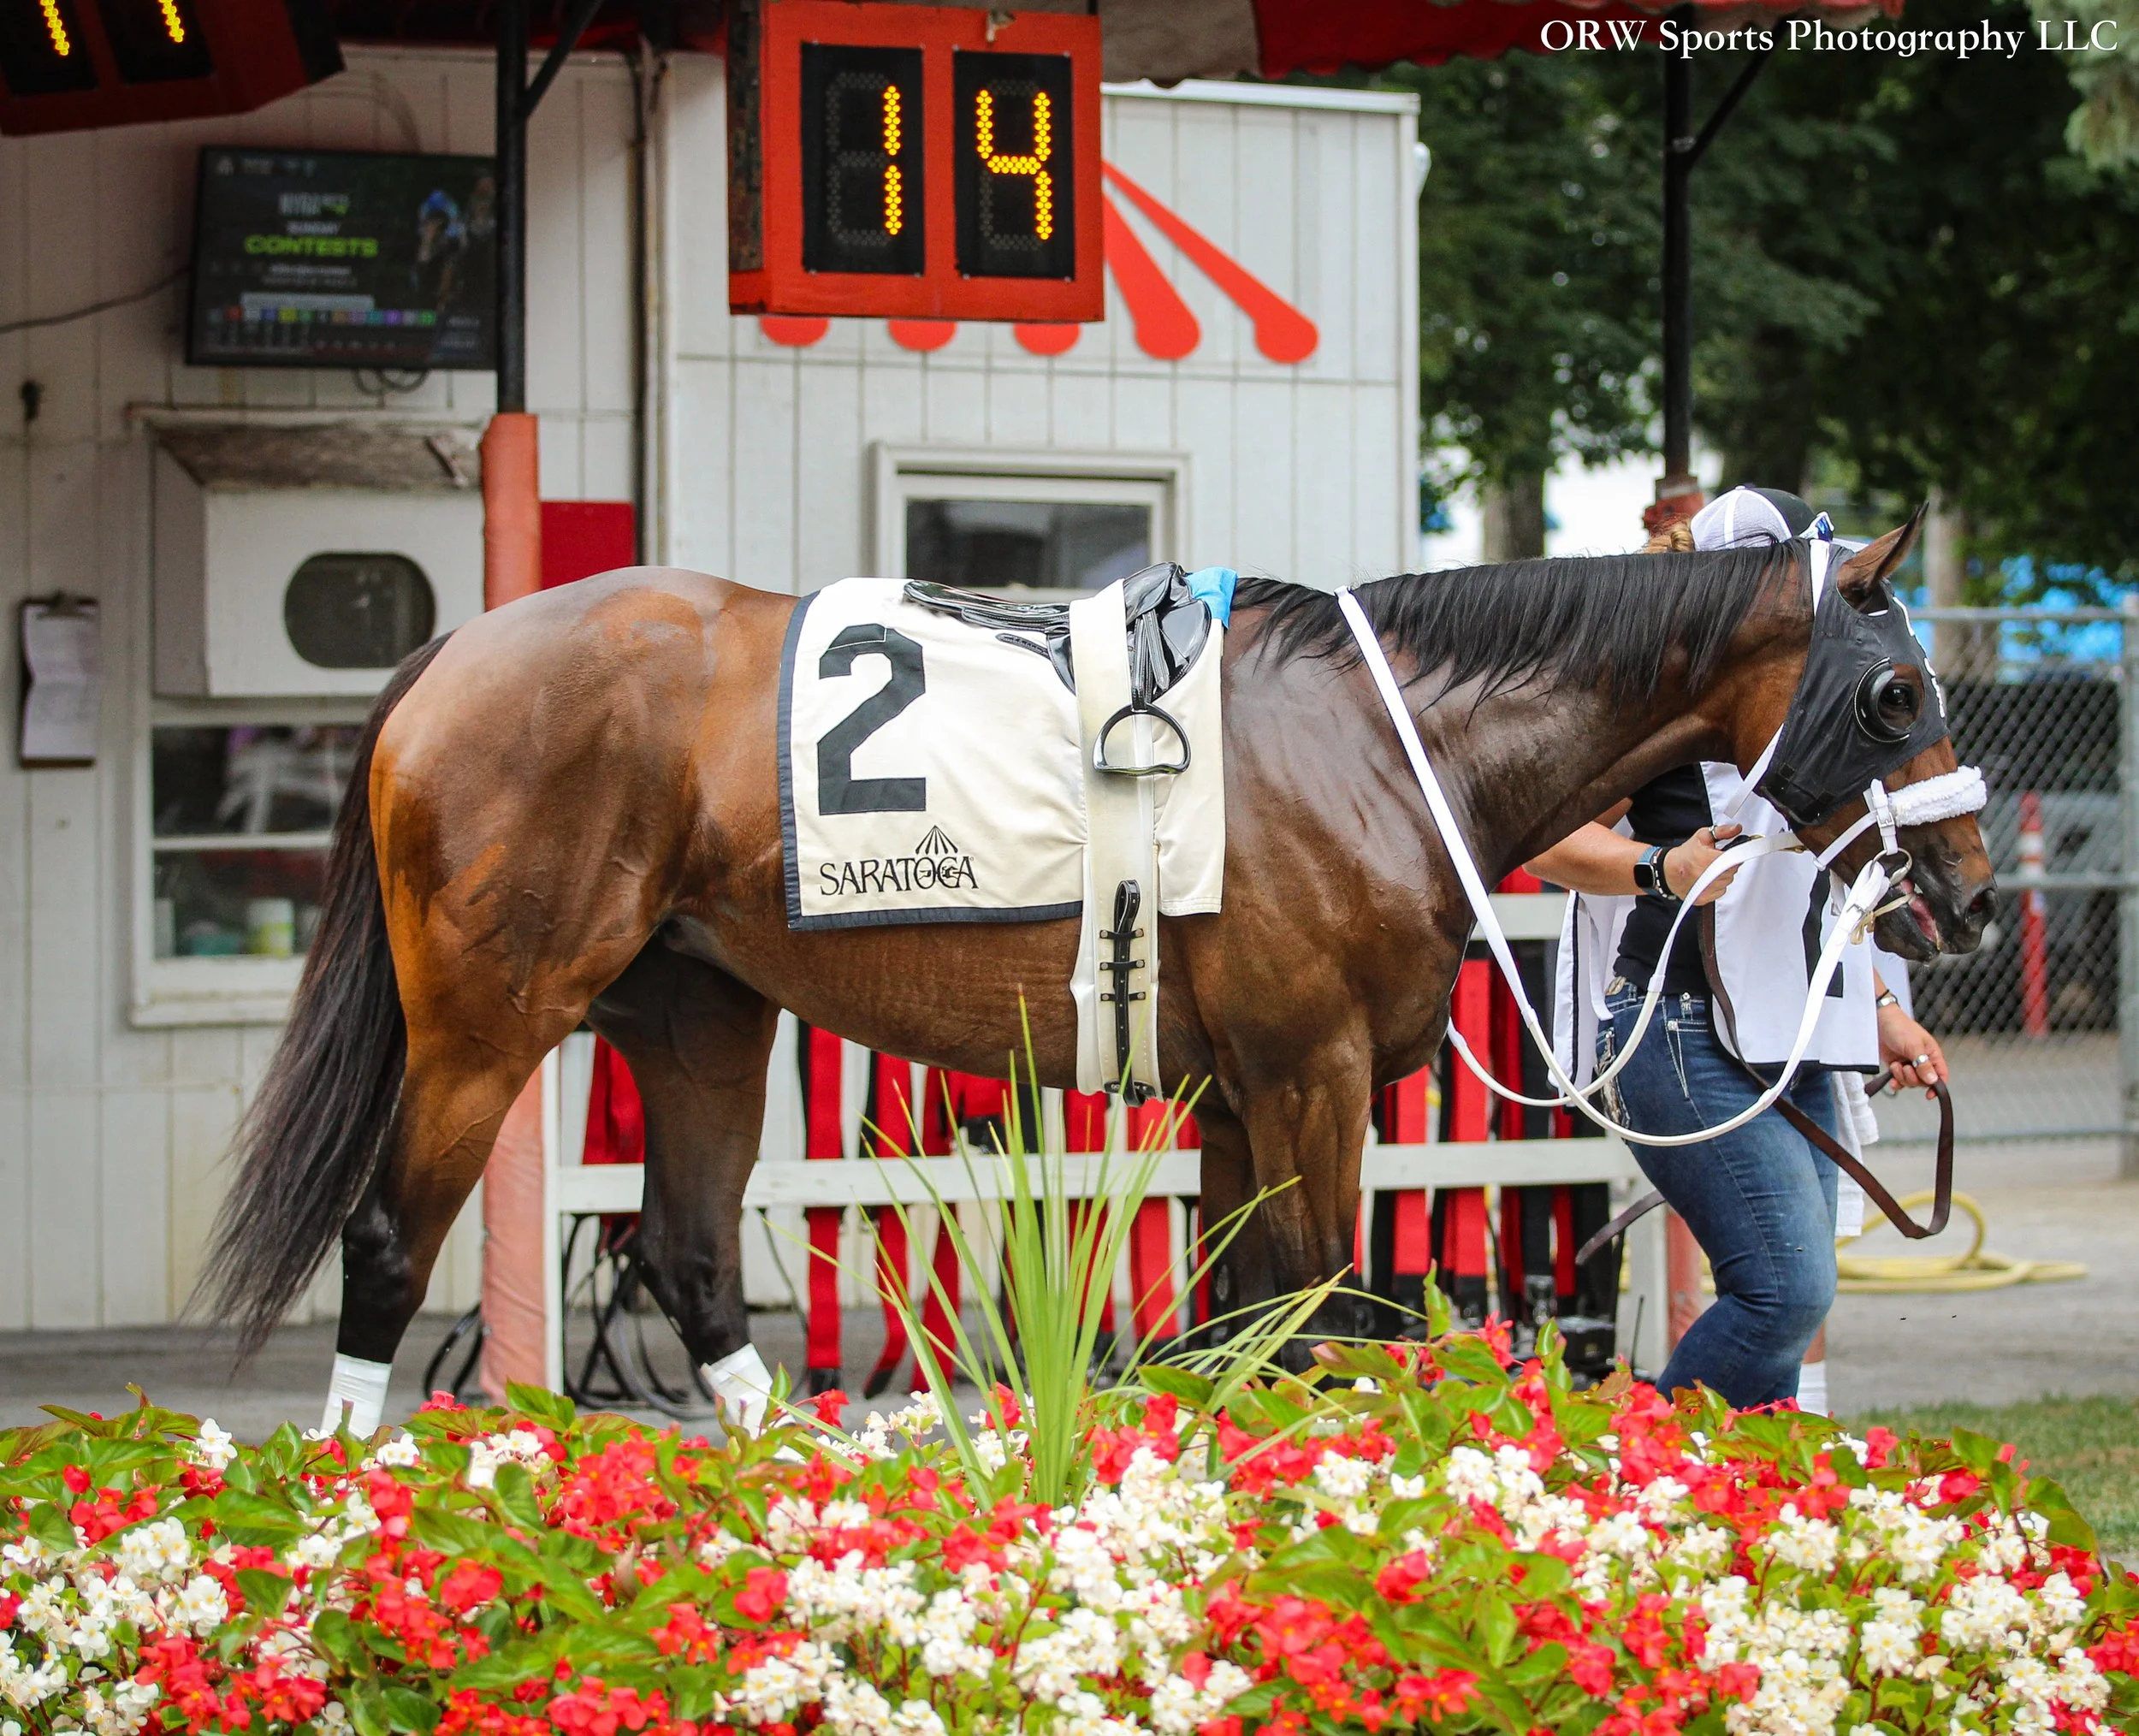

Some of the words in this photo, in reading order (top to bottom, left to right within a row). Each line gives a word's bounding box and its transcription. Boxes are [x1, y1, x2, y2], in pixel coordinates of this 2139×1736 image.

[883, 86, 1053, 240] 14
[817, 623, 926, 815] 2
[820, 856, 980, 896] SARATOGA
